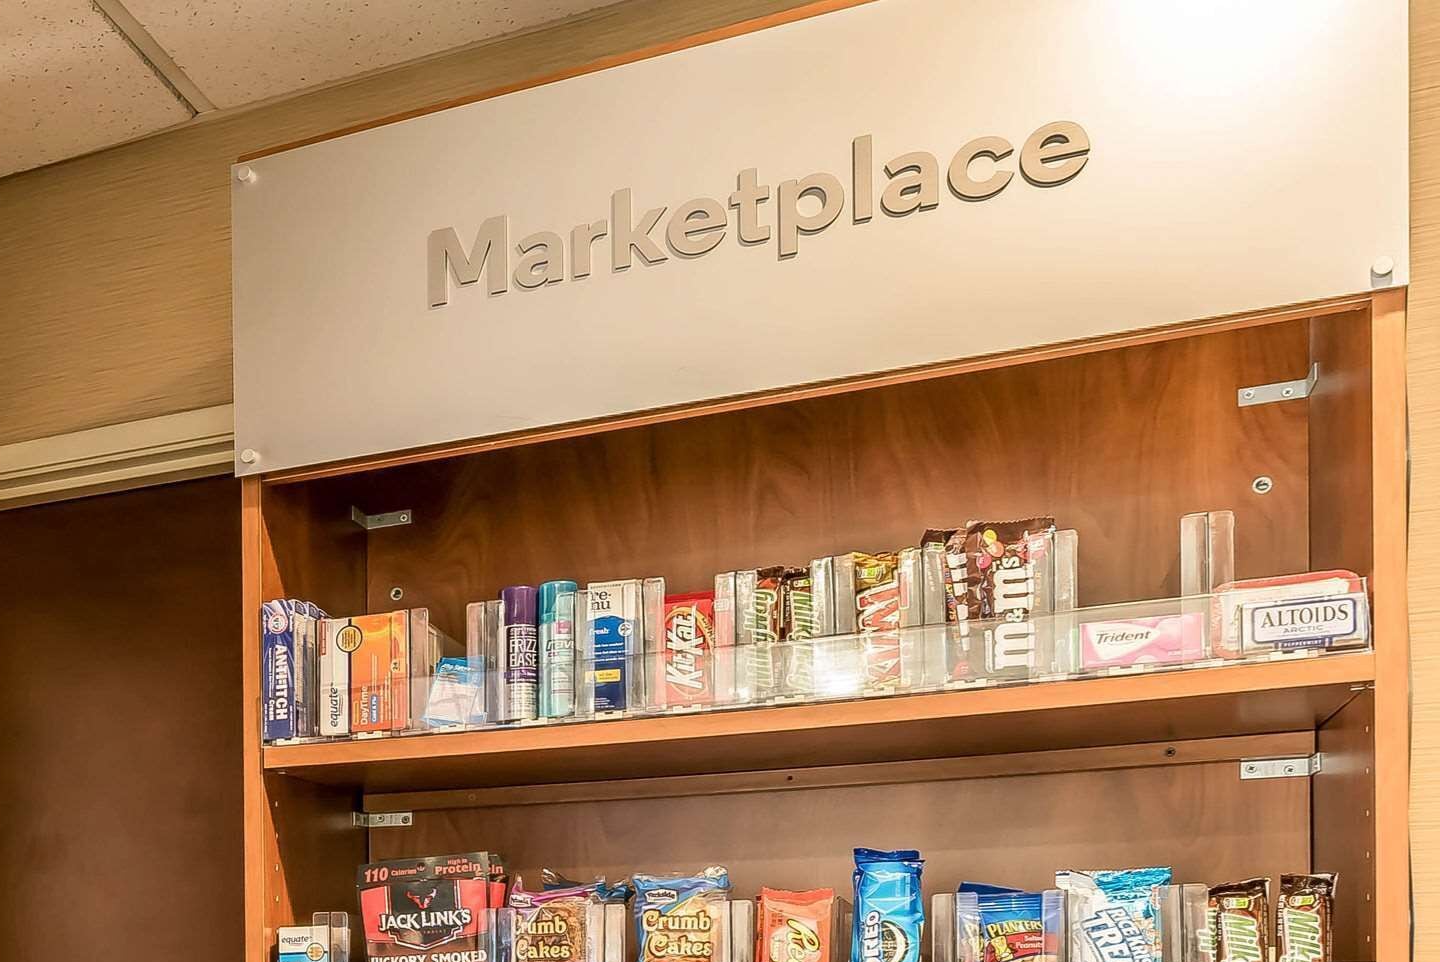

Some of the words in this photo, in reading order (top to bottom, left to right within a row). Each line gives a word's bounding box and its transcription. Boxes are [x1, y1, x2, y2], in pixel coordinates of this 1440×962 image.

[425, 117, 1093, 311] Marketplace
[1260, 602, 1350, 629] ALTOIDS
[1095, 629, 1152, 645] Trident
[1282, 624, 1324, 634] ARCTIC
[509, 639, 537, 653] FRIZZ
[1282, 639, 1324, 648] PEPPERMINT
[330, 687, 338, 728] equate
[360, 686, 369, 726] Daytime
[364, 867, 389, 883] 110
[435, 862, 481, 875] Protein
[379, 913, 420, 932] JACK
[421, 908, 472, 928] LINK'S
[642, 908, 712, 932] Crumb
[988, 920, 1043, 938] PLANTERS
[281, 935, 310, 945] equate
[516, 937, 572, 960] Cakes
[649, 932, 714, 958] Cakes
